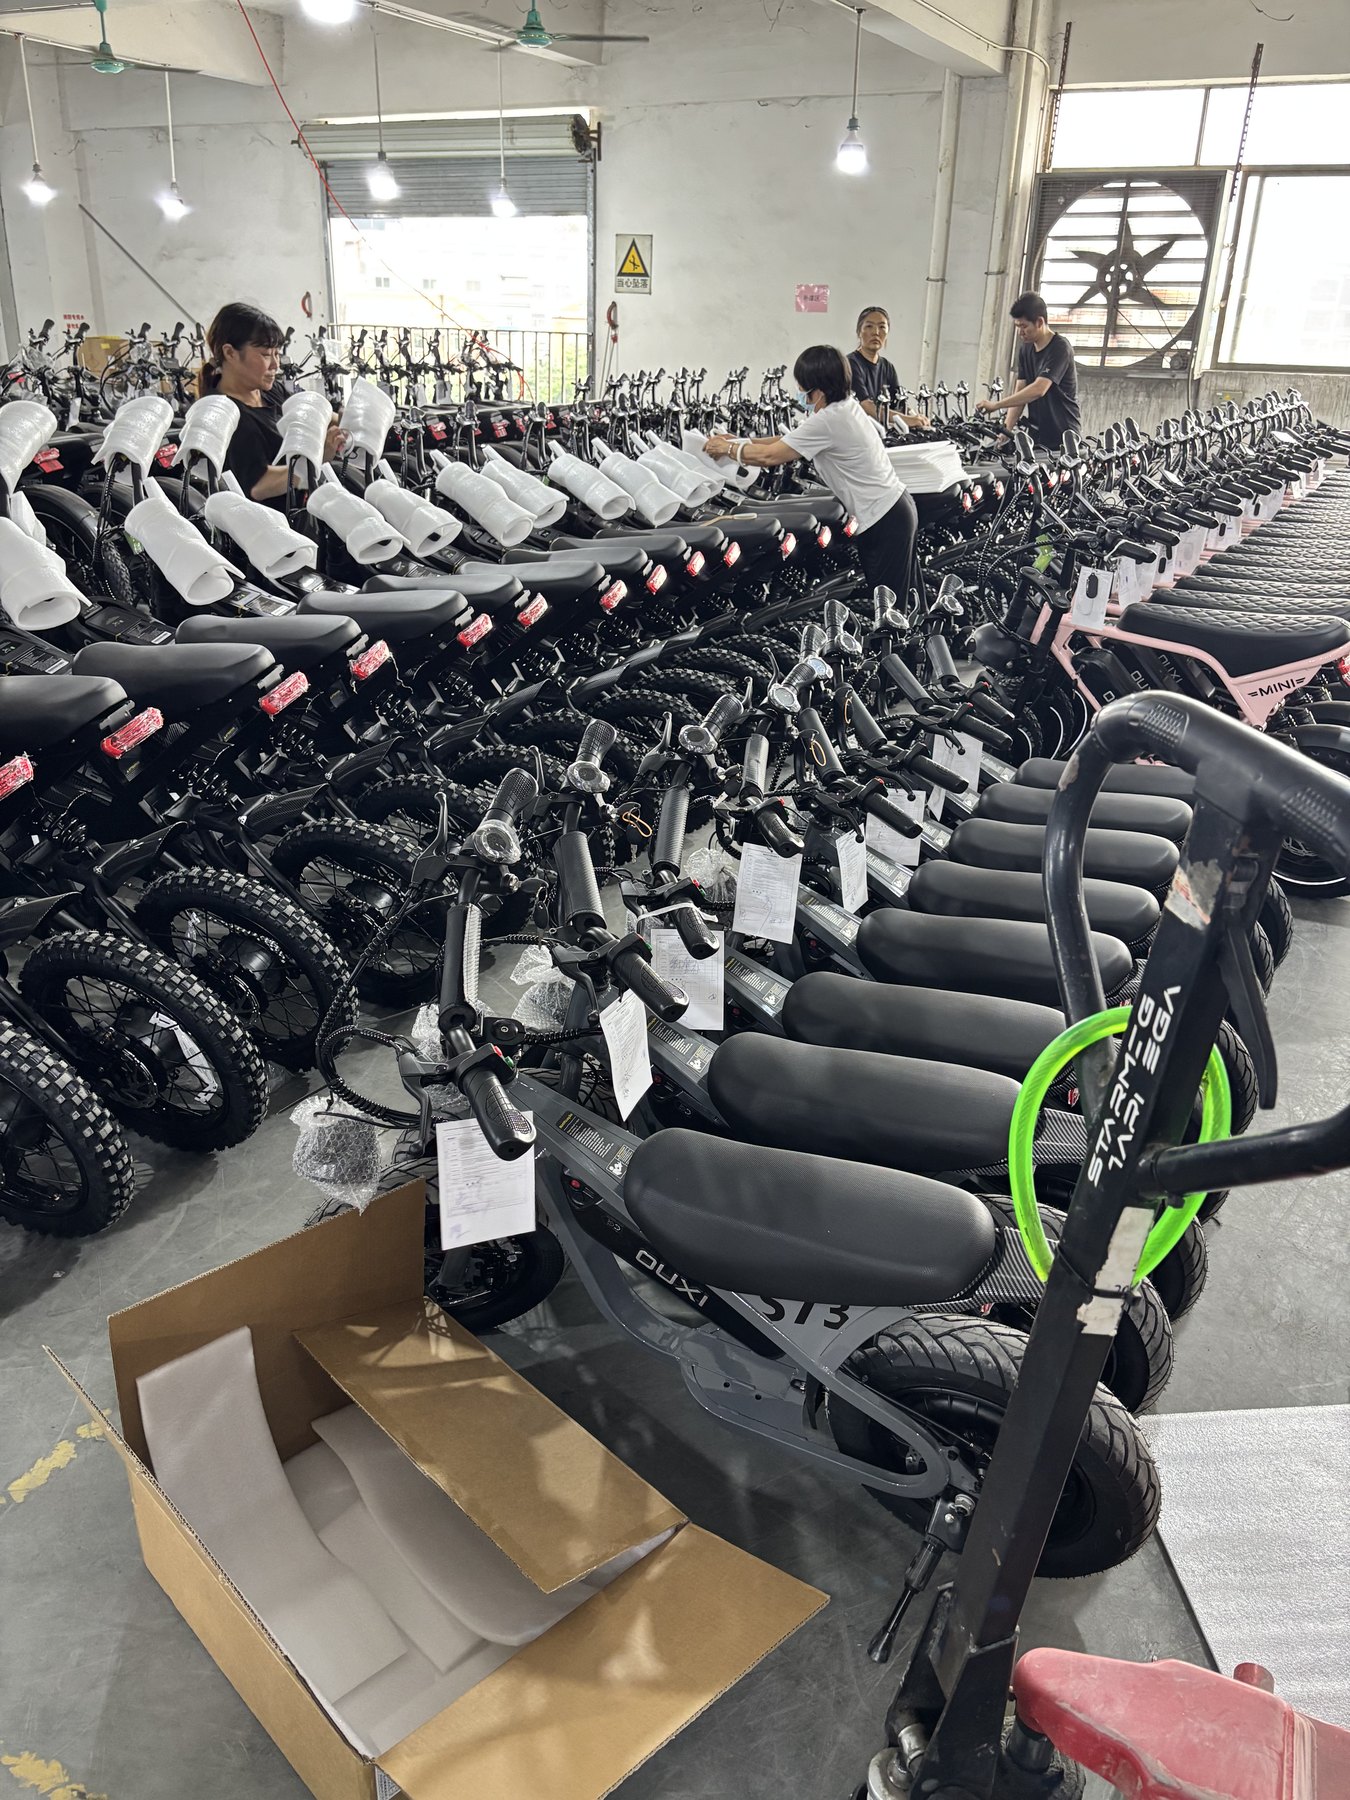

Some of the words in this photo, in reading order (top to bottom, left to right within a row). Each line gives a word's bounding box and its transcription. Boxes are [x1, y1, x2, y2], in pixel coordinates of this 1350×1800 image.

[617, 278, 648, 289] 当心坠落
[1130, 670, 1151, 691] OU
[1259, 678, 1296, 697] MINI
[635, 1249, 709, 1307] OUXI
